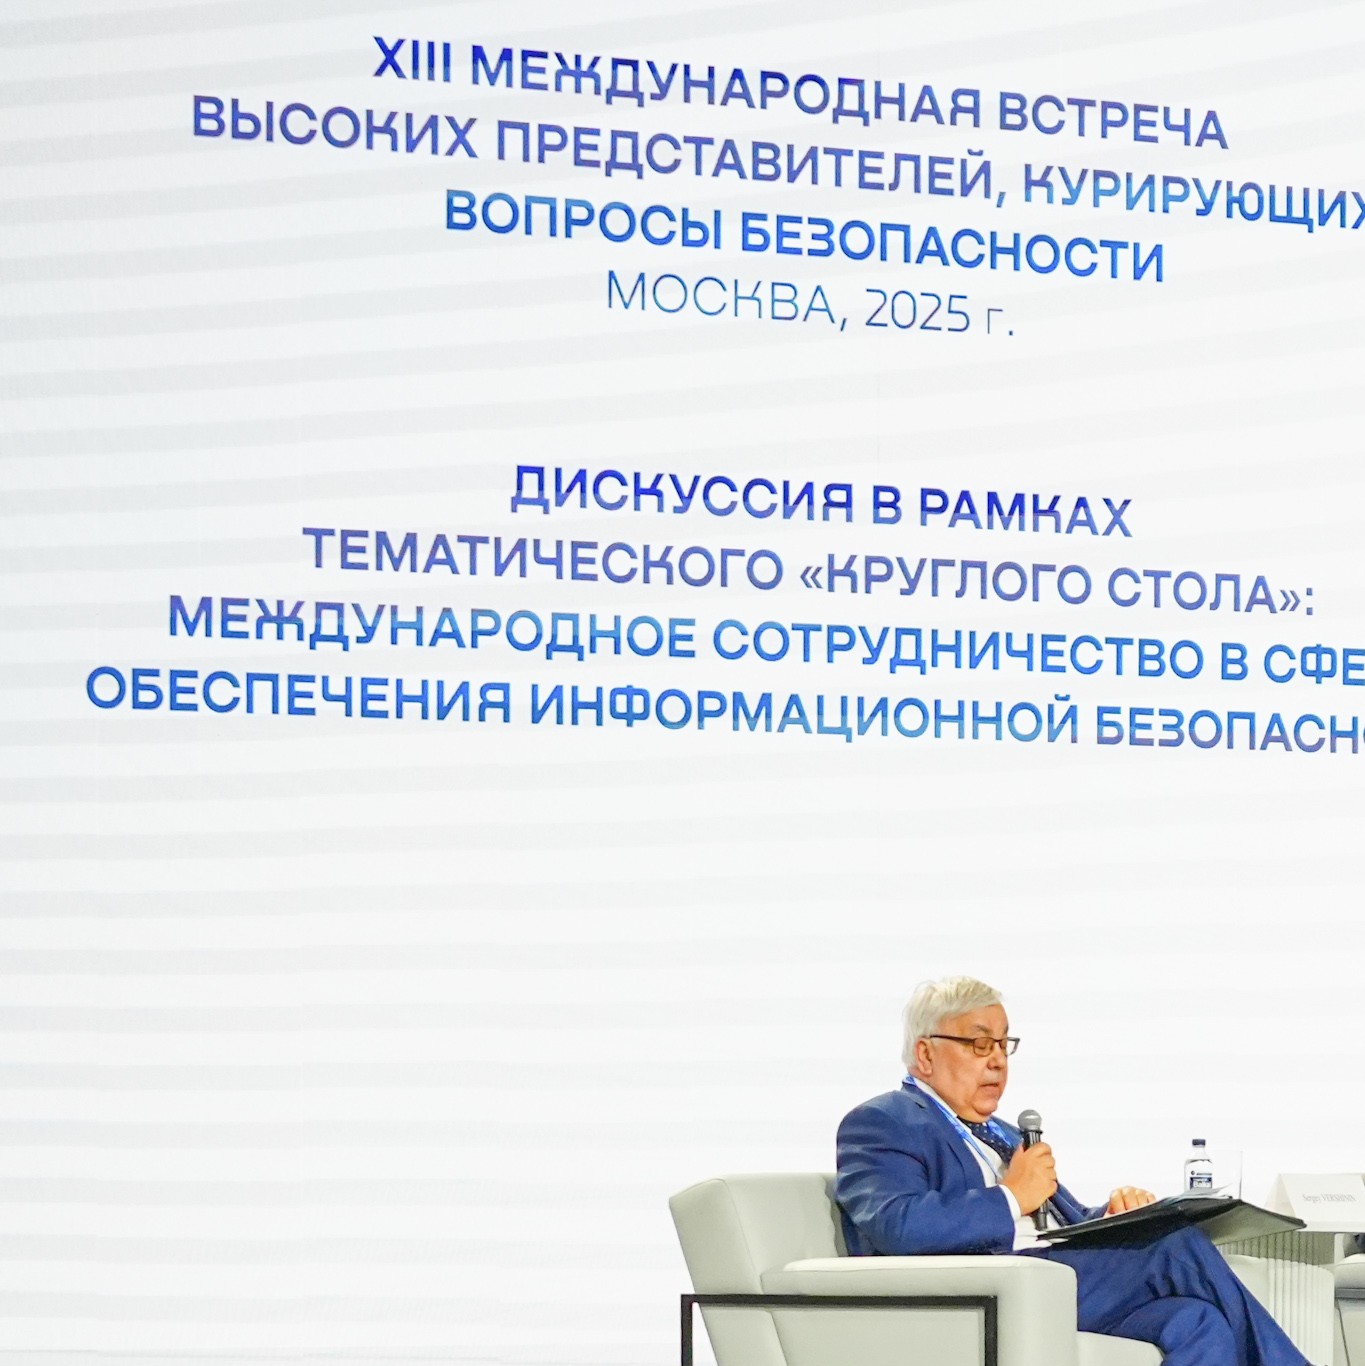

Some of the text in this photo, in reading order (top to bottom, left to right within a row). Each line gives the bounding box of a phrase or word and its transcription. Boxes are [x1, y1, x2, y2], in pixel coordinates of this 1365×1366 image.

[374, 36, 1228, 149] XIII МЕЖДУНАРОДНАЯ ВСТРЕЧА
[193, 96, 477, 159] ВЫСОКИХ
[497, 120, 1005, 208] ПРЕДСТАВИТЕЛЕЙ,
[445, 190, 1164, 283] ВОПРОСЫ БЕЗОПАСНОСТИ
[607, 269, 1014, 336] МОСКВА, 2025 г.
[511, 464, 1131, 537] ДИСКУССИЯ В РАМКАХ
[303, 528, 1313, 615] ТЕМАТИЧЕСКОГО «КРУГЛОГО СТОЛА»:
[169, 596, 697, 662] МЕЖДУНАРОДНОЕ
[712, 619, 1204, 680] СОТРУДНИЧЕСТВО
[1221, 642, 1249, 681] В
[86, 666, 511, 724] ОБЕСПЕЧЕНИЯ
[531, 683, 1078, 743] ИНФОРМАЦИОННОЙ
